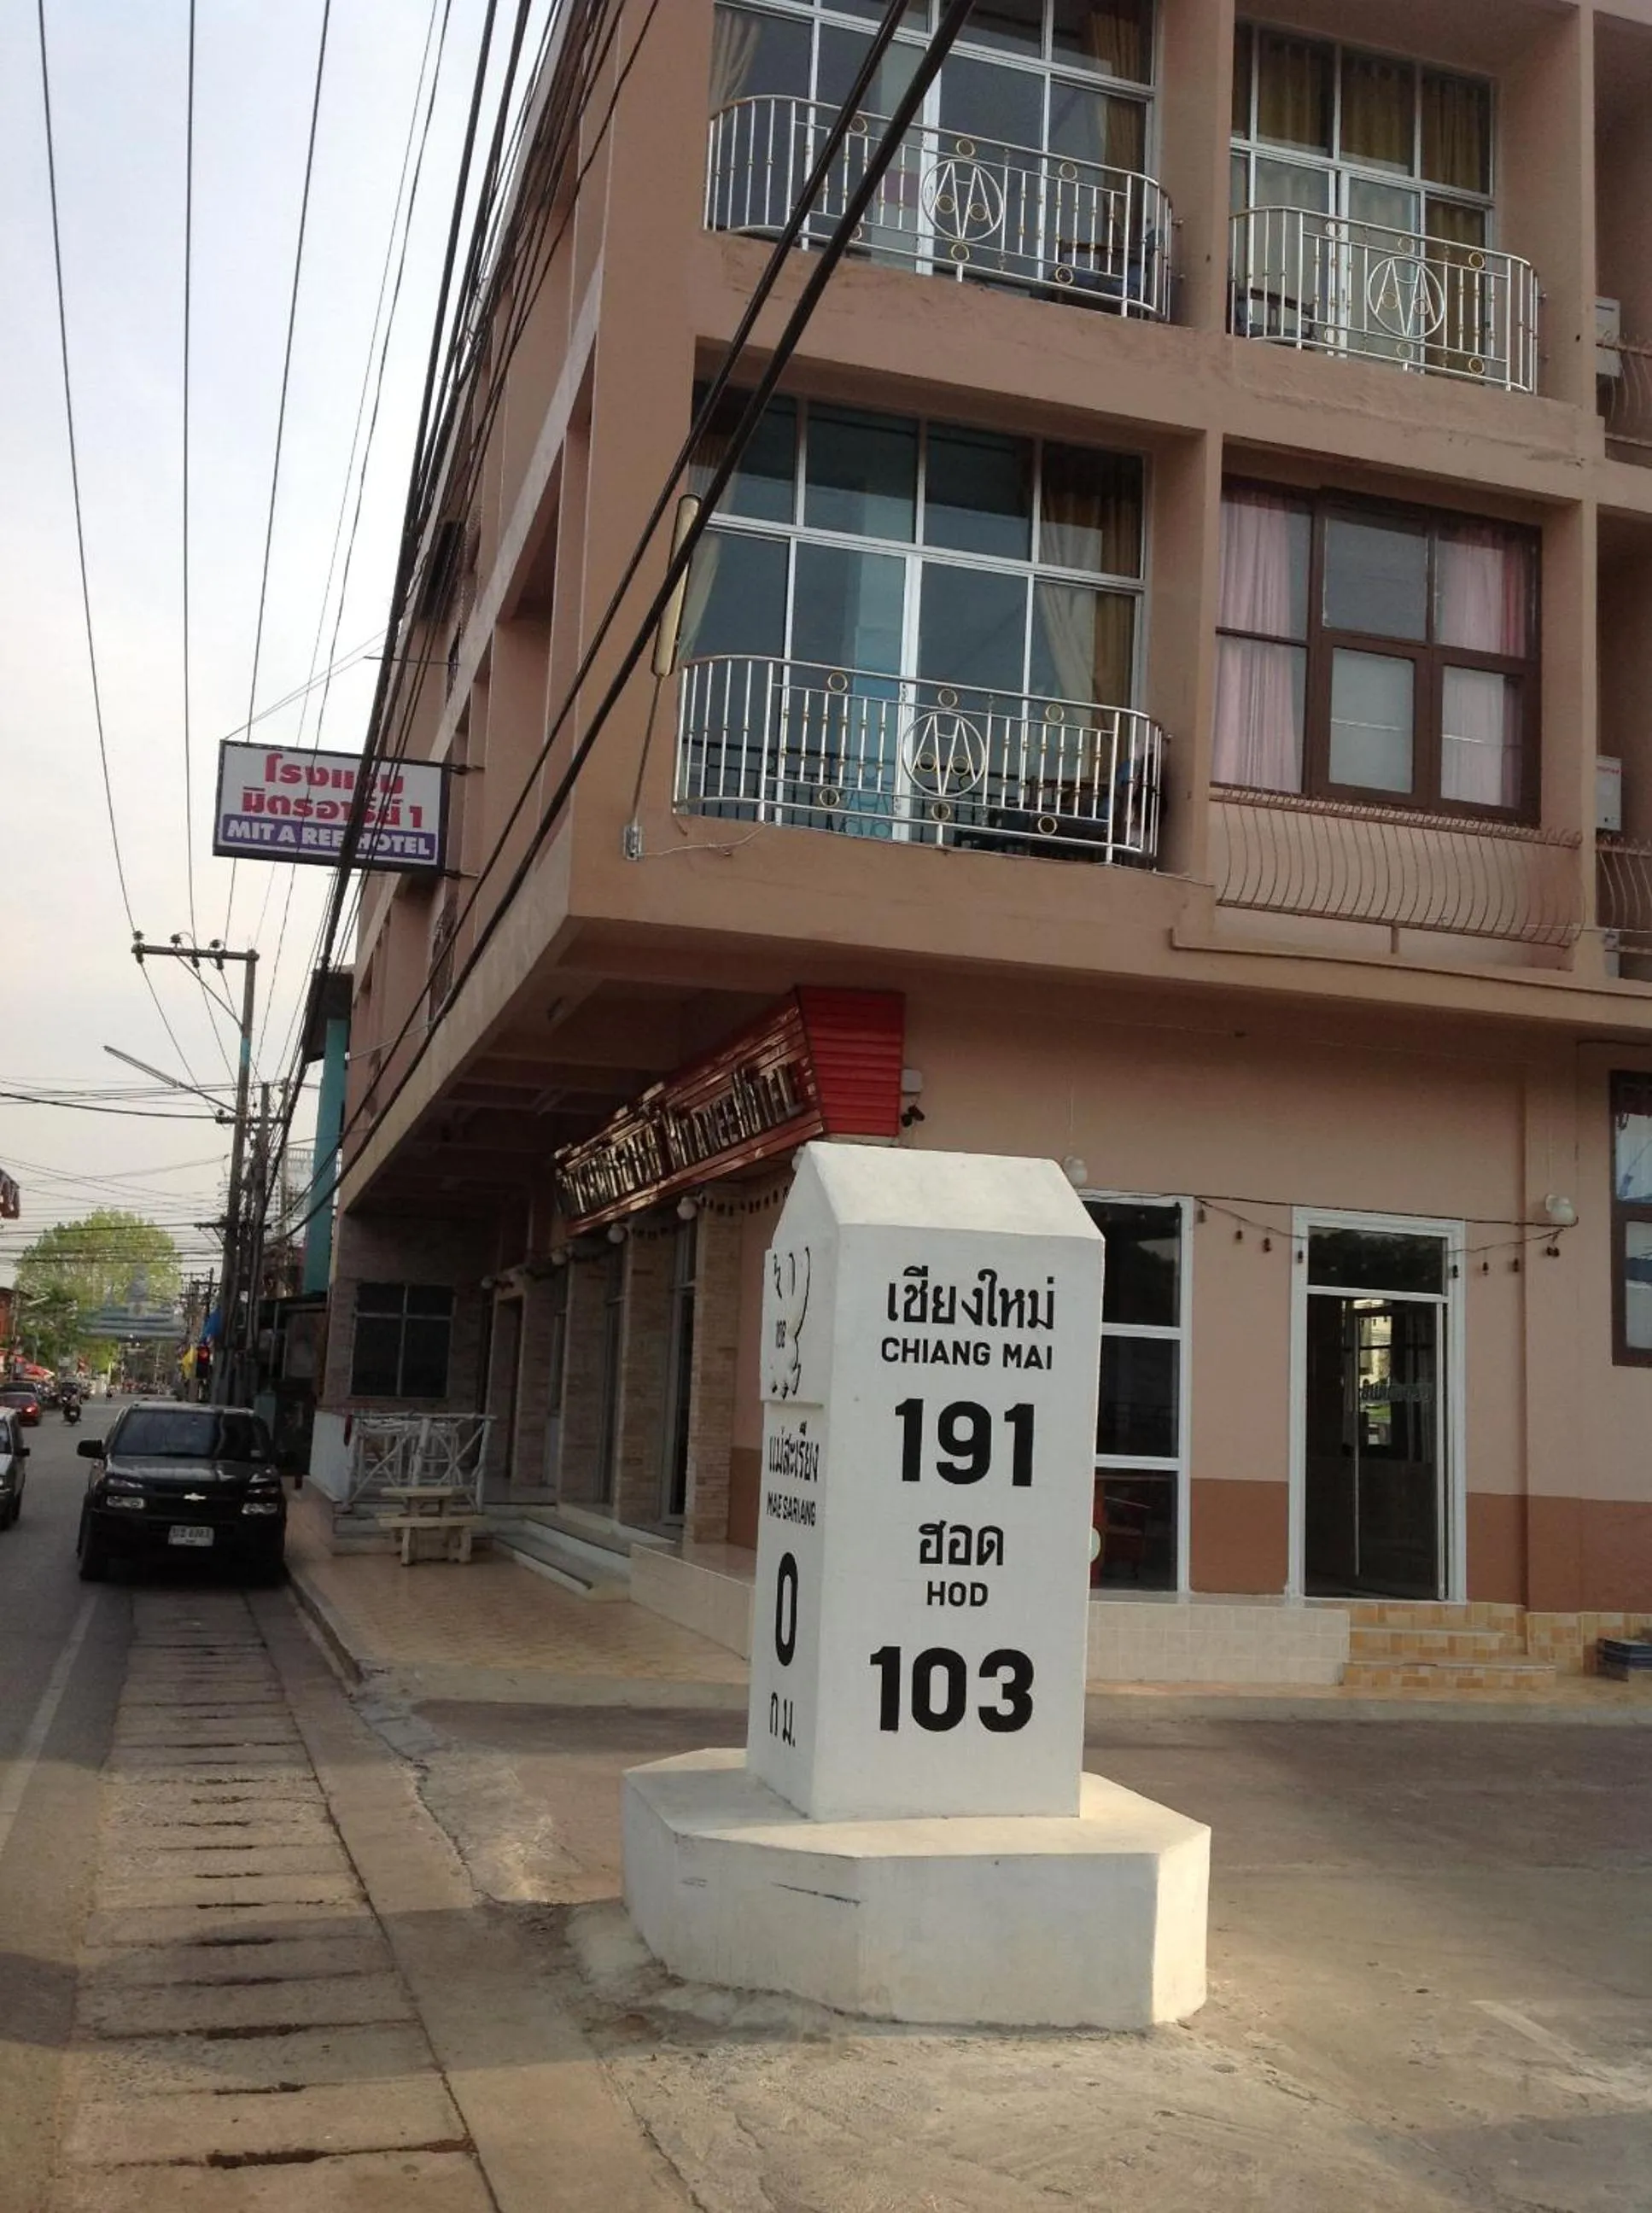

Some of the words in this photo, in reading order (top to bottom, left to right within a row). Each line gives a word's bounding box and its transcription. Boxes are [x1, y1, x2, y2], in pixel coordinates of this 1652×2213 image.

[265, 753, 404, 794] โรงแม
[227, 820, 274, 841] MIT
[277, 825, 296, 844] A
[357, 832, 430, 855] HOTEL
[888, 1265, 1054, 1329] เชียงใหม่
[881, 1337, 991, 1367] CHIANG
[1002, 1343, 1053, 1370] MAI
[768, 1421, 820, 1483] แม่สะเรียง
[895, 1398, 1035, 1486] 191
[767, 1492, 782, 1520] MAE
[782, 1495, 817, 1527] SARIANG
[919, 1520, 1004, 1566] ฮอด
[775, 1552, 798, 1667] 0
[927, 1580, 989, 1608] HOD
[870, 1646, 1035, 1733] 103
